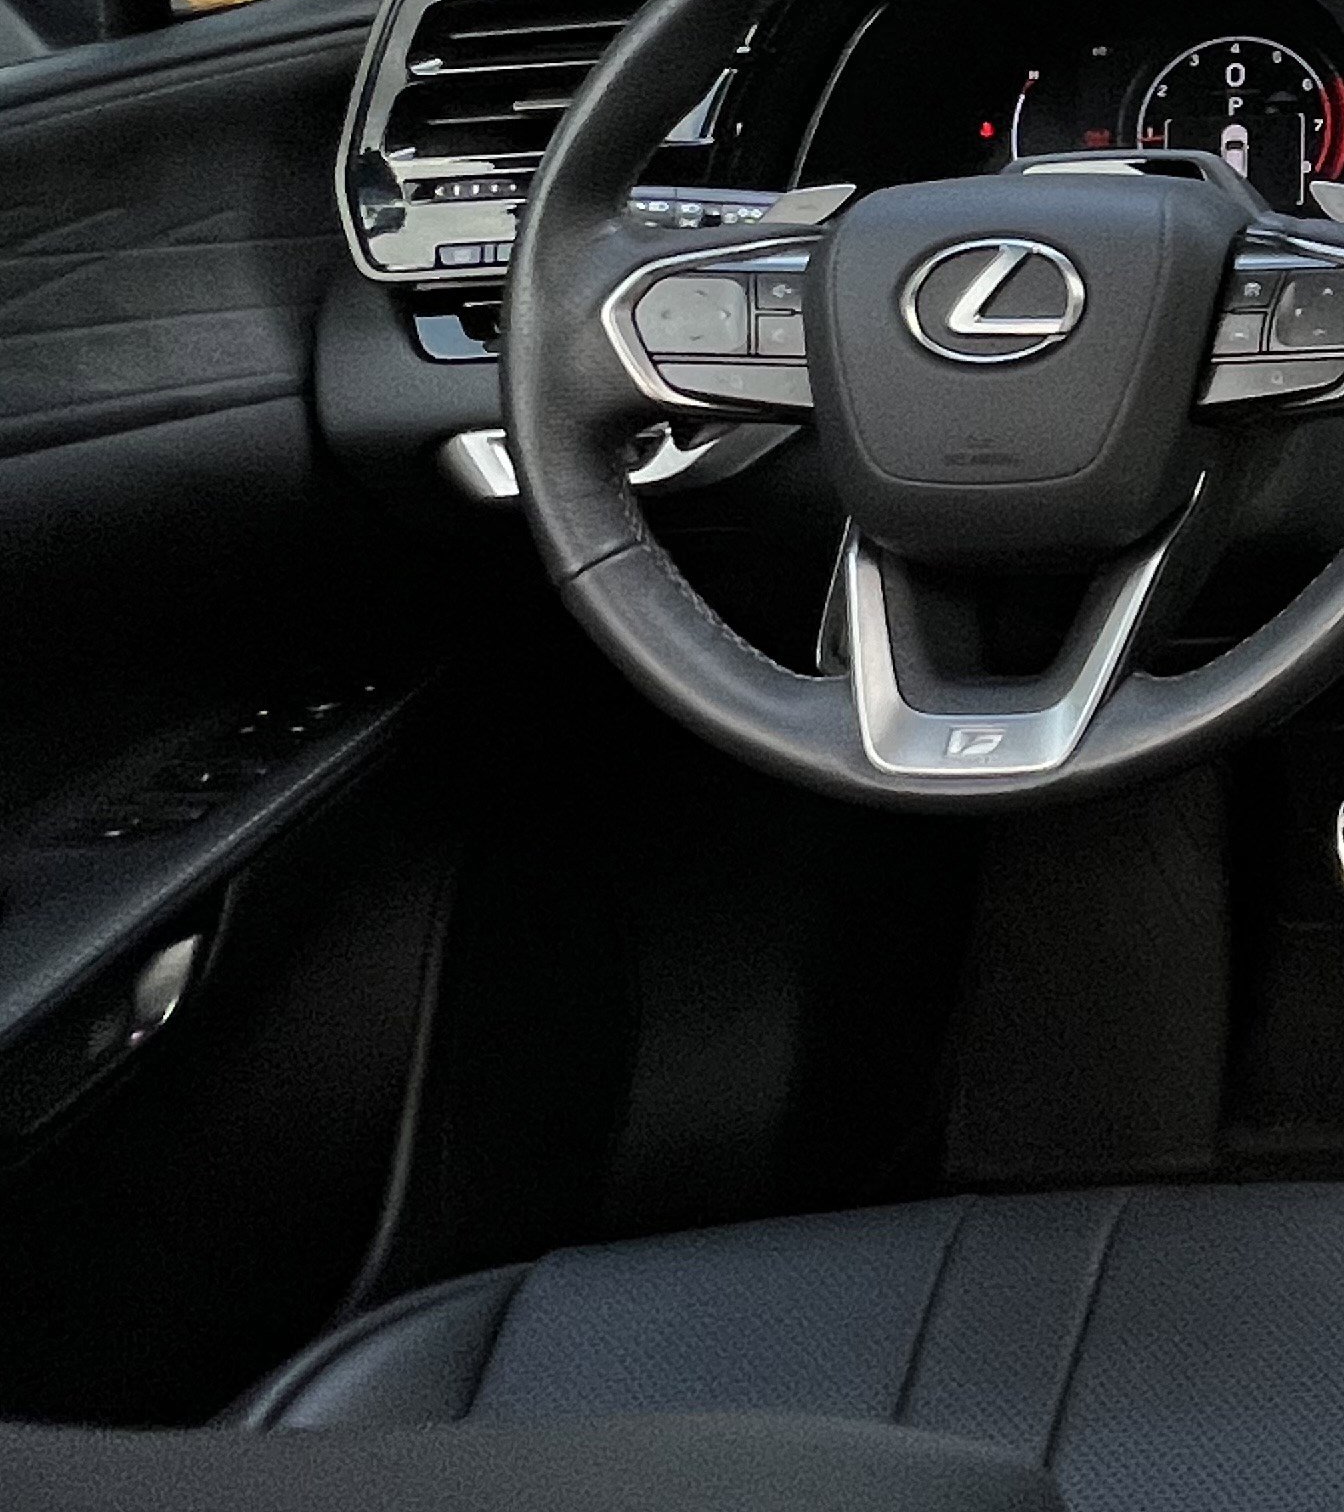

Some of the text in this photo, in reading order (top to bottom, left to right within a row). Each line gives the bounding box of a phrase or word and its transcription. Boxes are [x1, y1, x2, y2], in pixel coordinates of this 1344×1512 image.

[1230, 42, 1241, 55] 4
[1188, 54, 1200, 67] 3
[1225, 62, 1246, 88] 0
[1156, 85, 1168, 98] 2
[1228, 96, 1244, 116] P
[1313, 118, 1324, 132] 7
